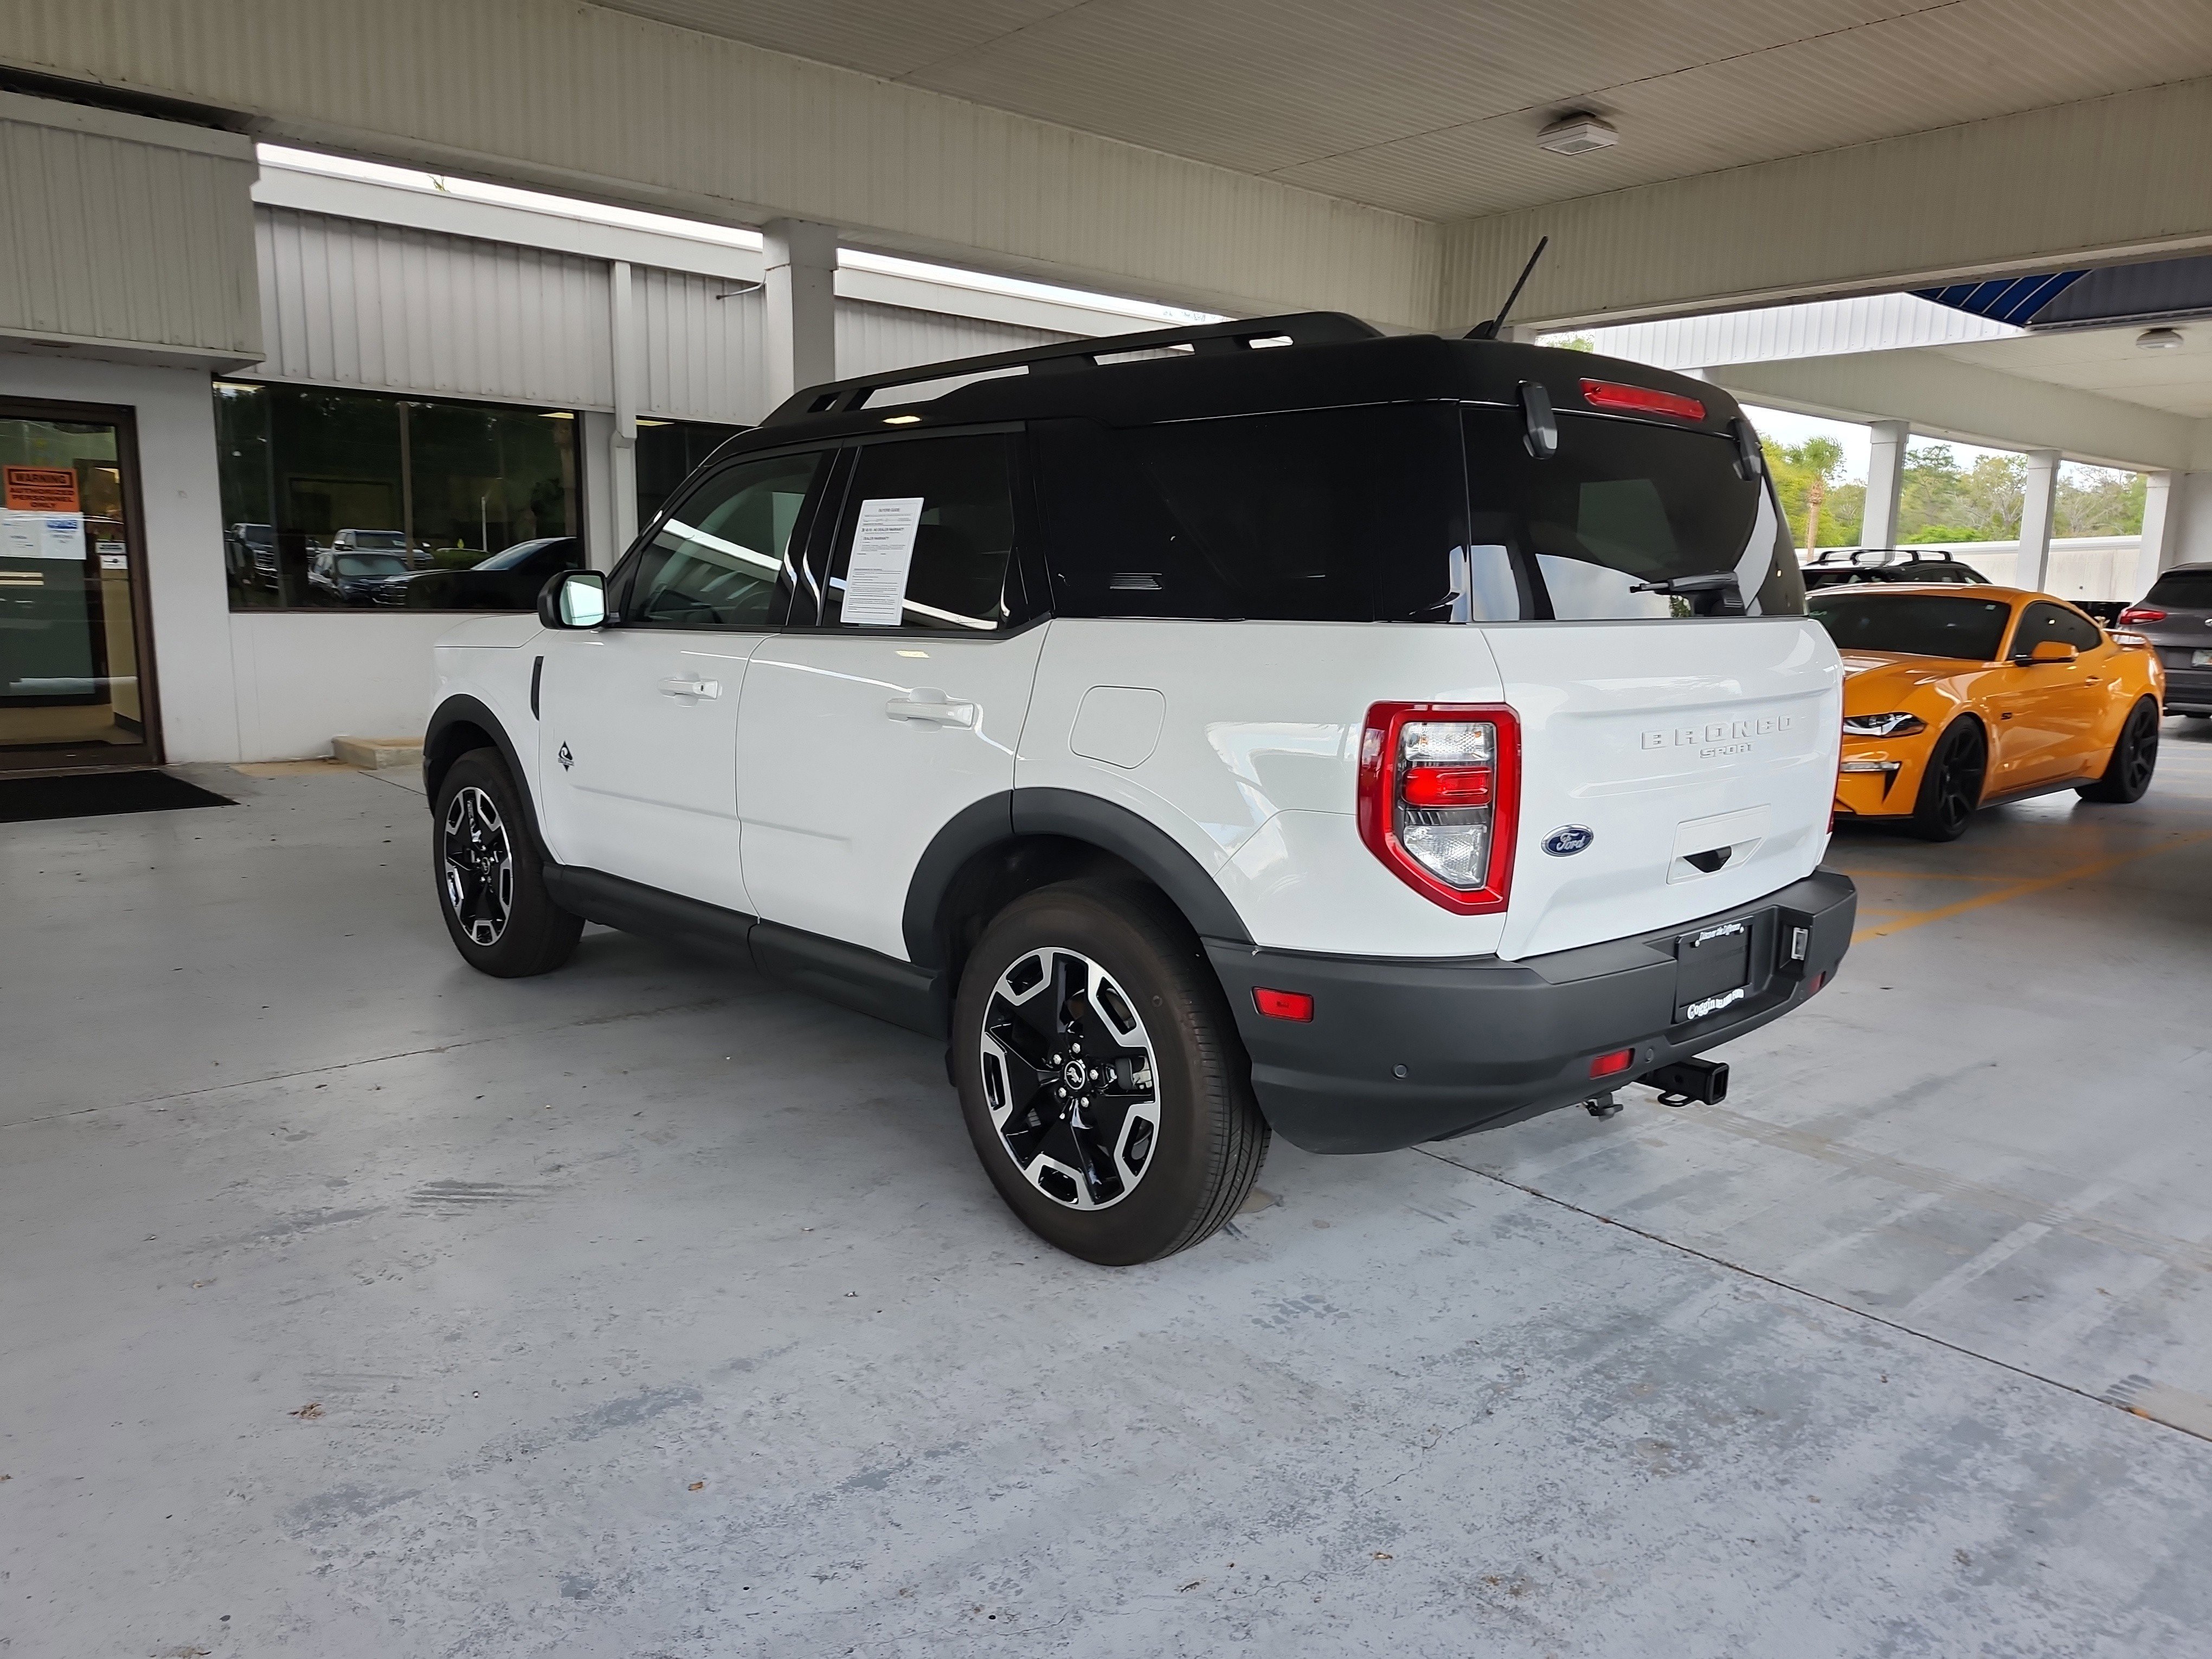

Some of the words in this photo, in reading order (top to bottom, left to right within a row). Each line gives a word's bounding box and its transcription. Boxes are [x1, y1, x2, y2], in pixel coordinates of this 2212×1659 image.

[16, 473, 67, 484] WARNING
[12, 494, 74, 503] PERSONNEL
[1642, 715, 1794, 750] BRONCO
[1700, 741, 1756, 758] SPORT
[1556, 833, 1586, 851] Ford
[1687, 998, 1716, 1020] Coggin
